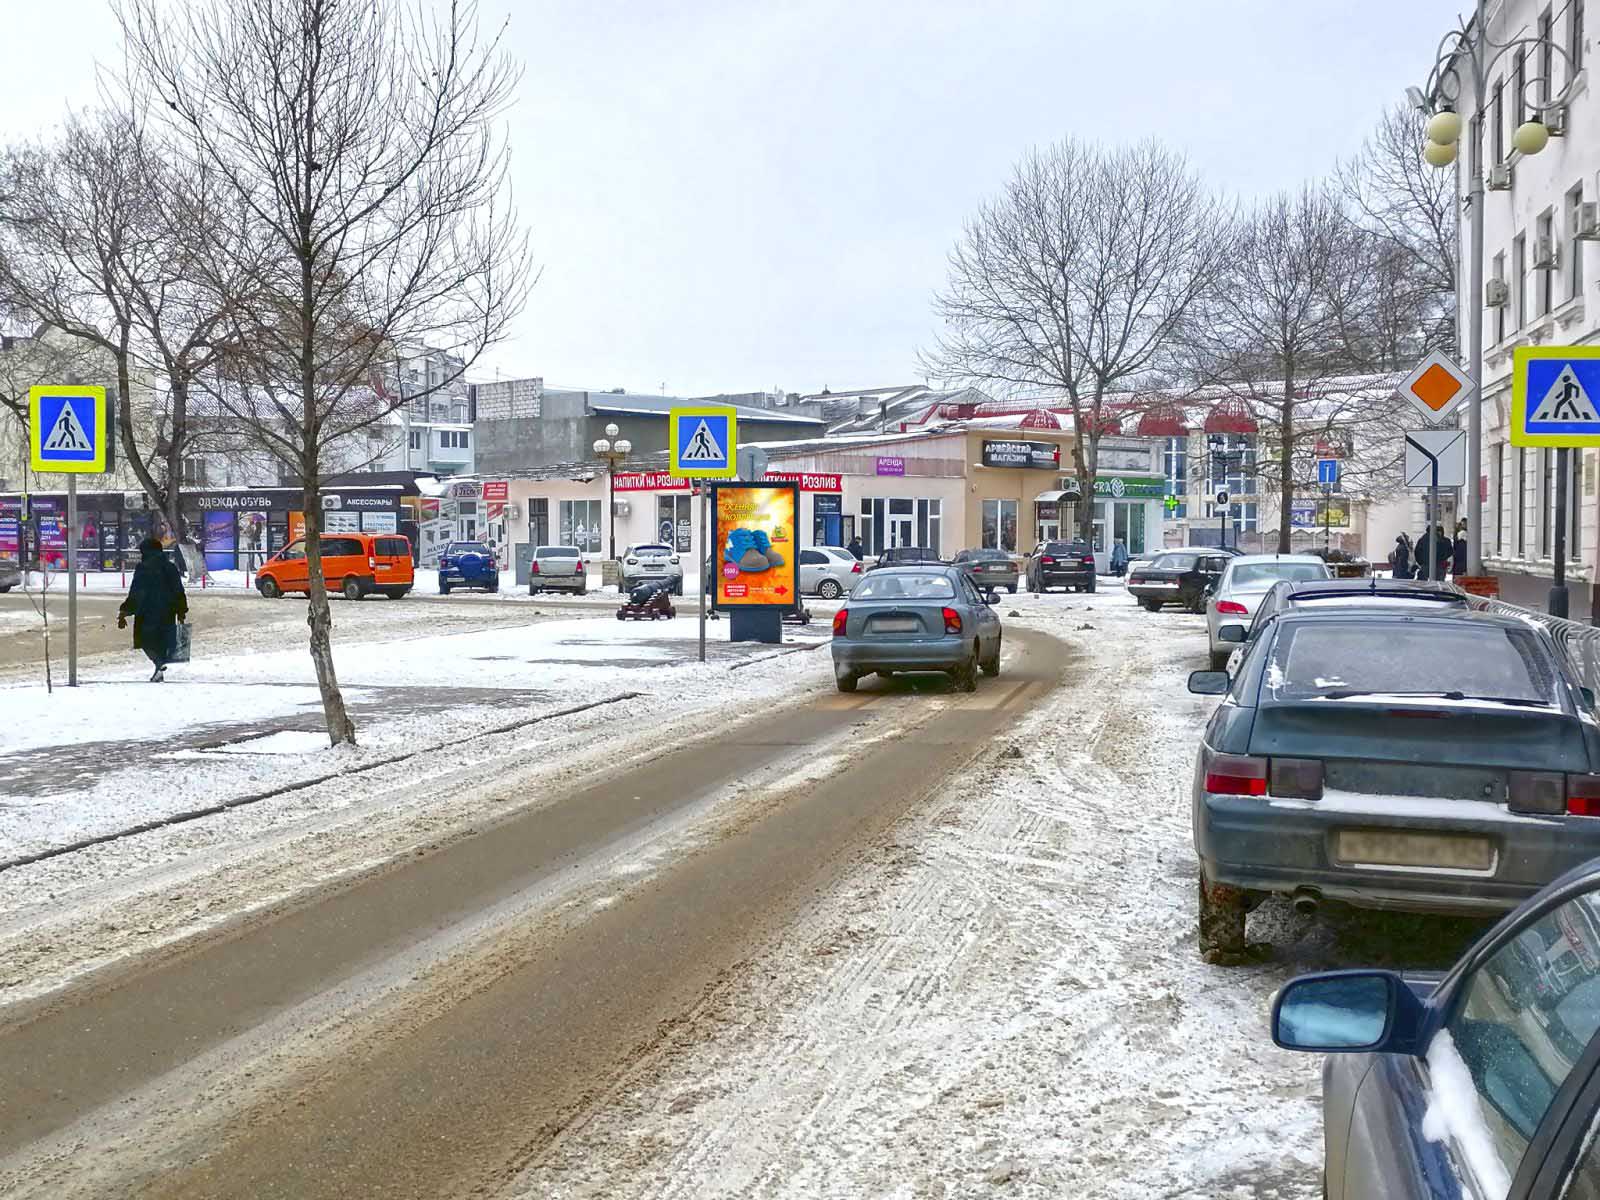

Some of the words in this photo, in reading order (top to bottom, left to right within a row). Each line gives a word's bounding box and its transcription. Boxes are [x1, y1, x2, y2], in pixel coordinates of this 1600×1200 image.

[985, 443, 1032, 454] АРМЕЙСКИЙ
[879, 458, 904, 467] АРЕНДА
[990, 453, 1027, 463] МАГАЗИН
[613, 475, 645, 489] НАПИТКИ
[645, 475, 656, 488] НА
[802, 474, 837, 489] РОЗЛИВ
[198, 497, 240, 509] ОДЕЖДА
[240, 497, 273, 507] ОБУВЬ
[346, 498, 394, 507] АКСЕССУАРЫ
